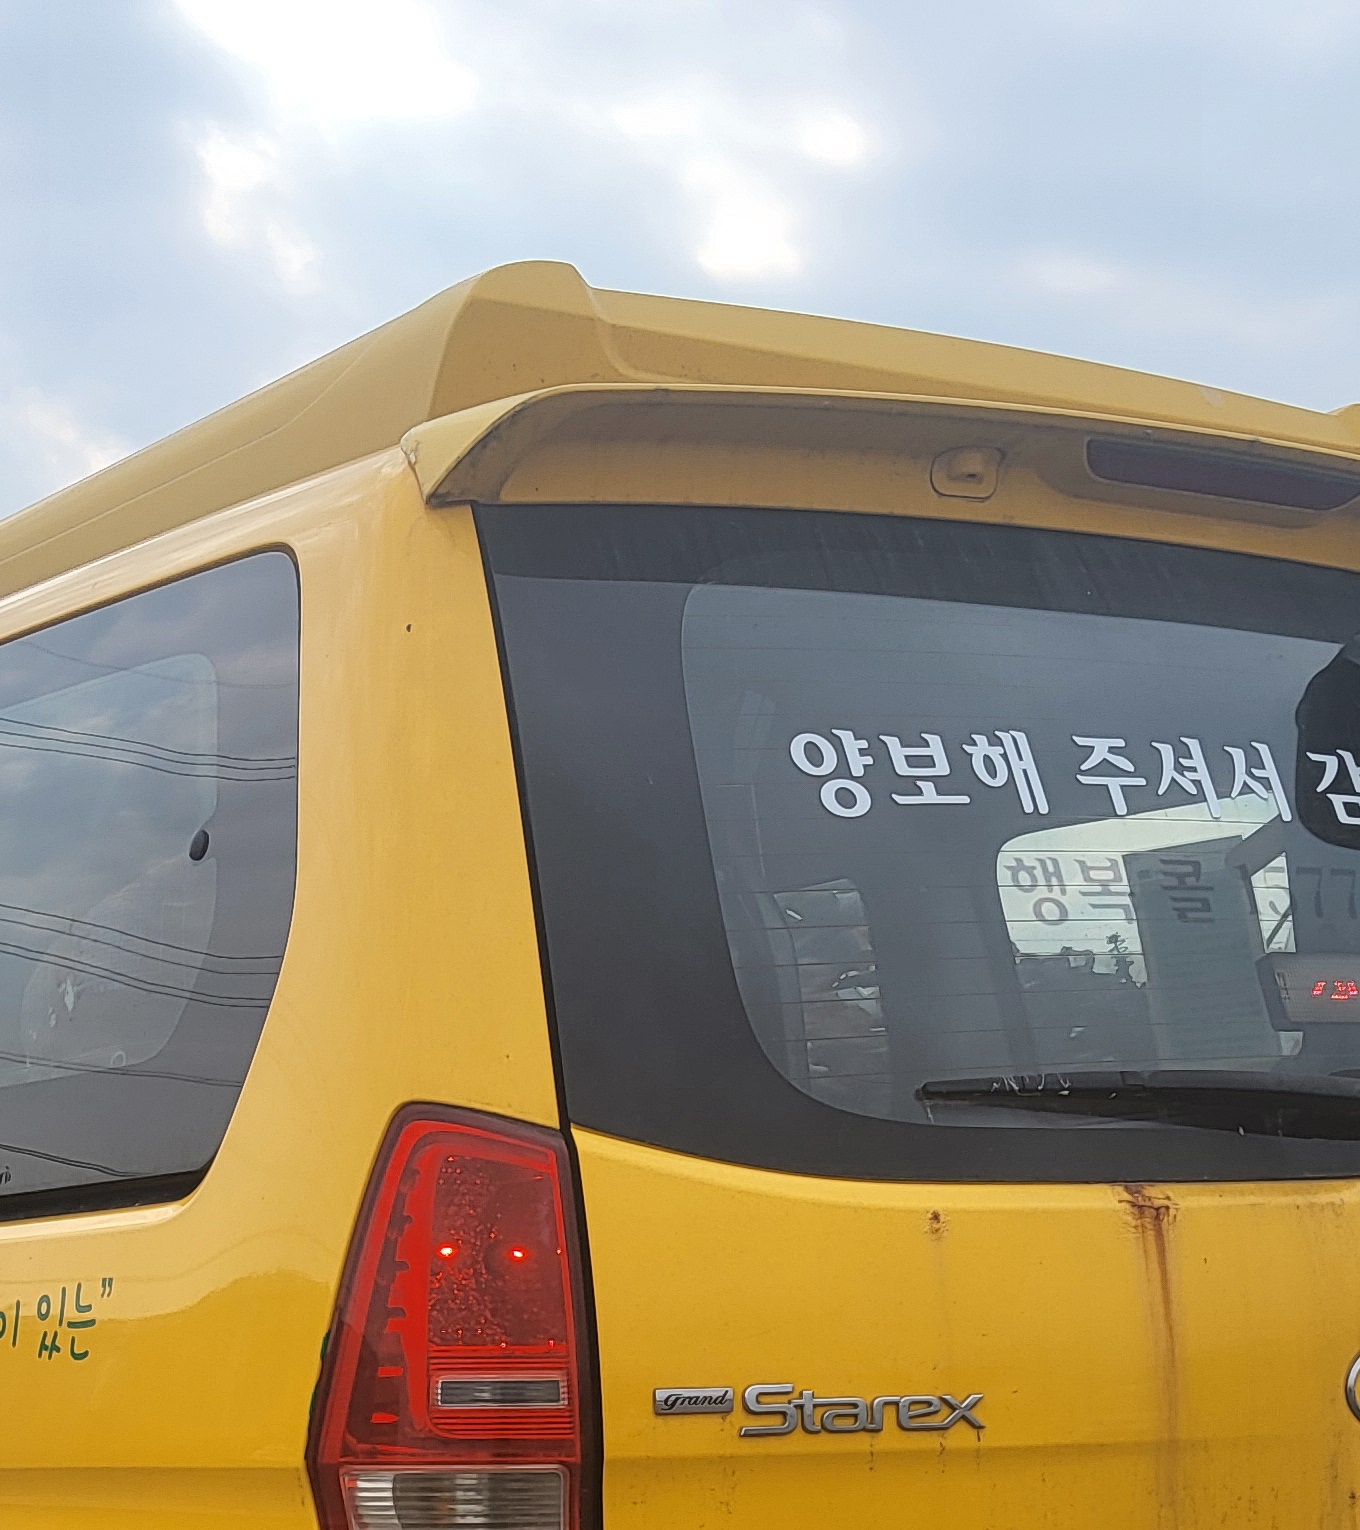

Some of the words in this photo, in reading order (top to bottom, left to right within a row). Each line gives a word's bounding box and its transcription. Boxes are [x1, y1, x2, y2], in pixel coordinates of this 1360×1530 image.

[789, 728, 1050, 819] 양보해
[1071, 734, 1292, 822] 주셔서
[1003, 856, 1134, 925] 행복
[1159, 858, 1215, 923] 콜
[660, 1389, 729, 1411] Grand
[740, 1383, 986, 1437] Starex
